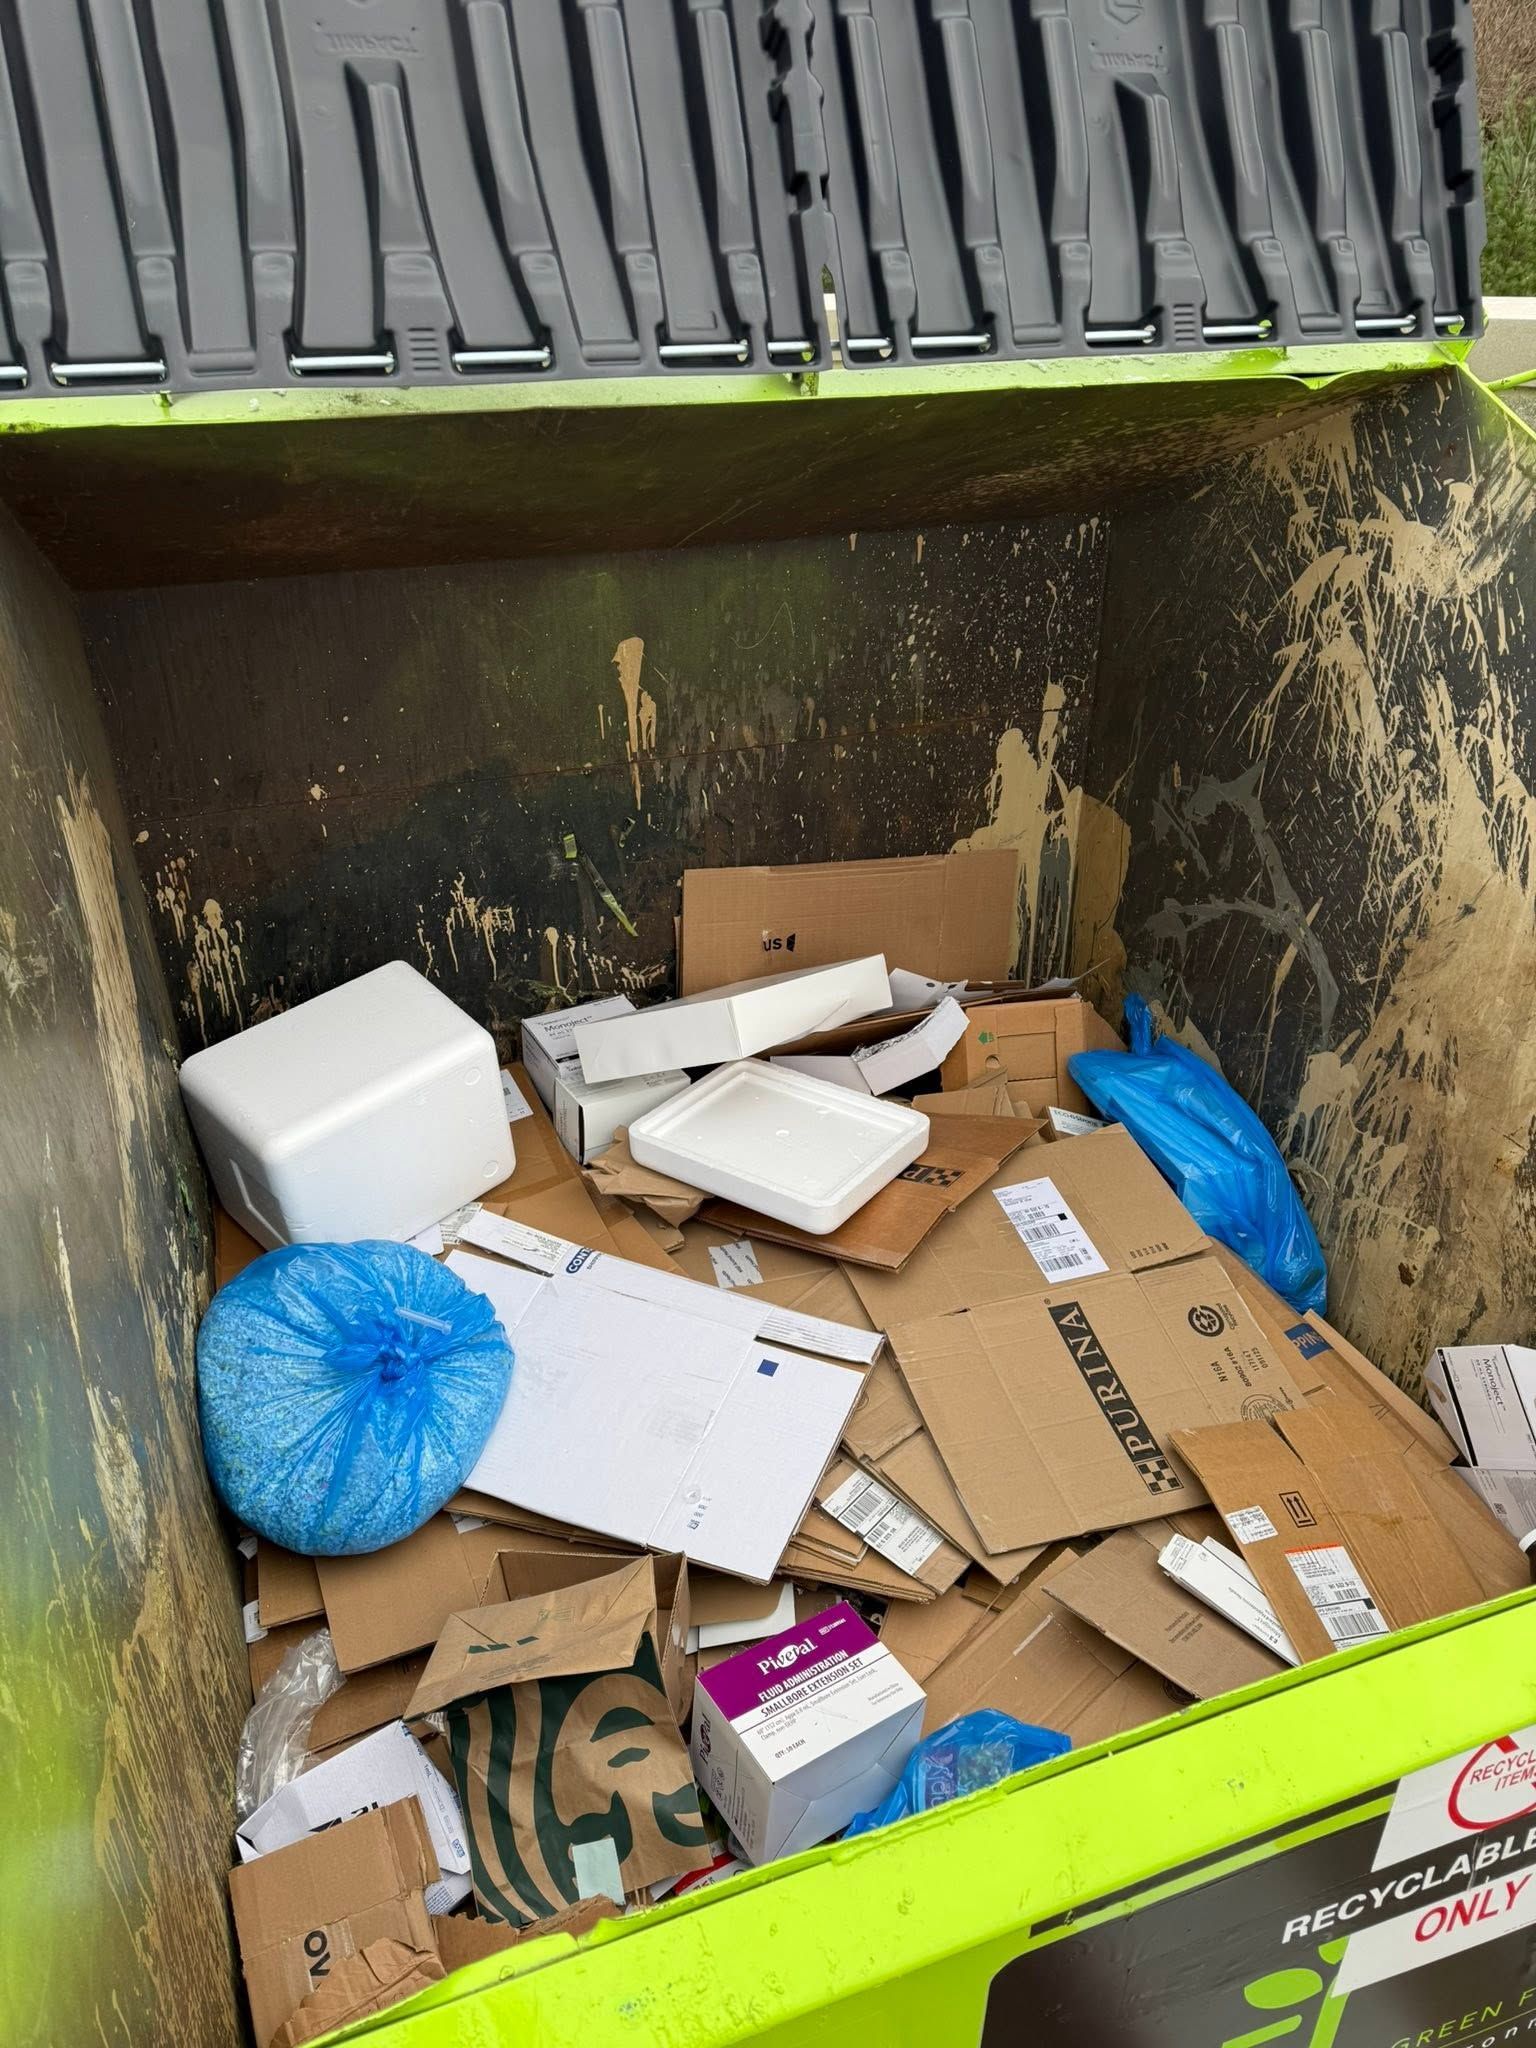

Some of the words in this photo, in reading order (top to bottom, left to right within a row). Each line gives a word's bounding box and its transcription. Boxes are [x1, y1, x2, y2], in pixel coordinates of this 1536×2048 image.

[1058, 1306, 1158, 1457] PURINA
[1482, 1358, 1504, 1406] Monoject
[757, 1638, 818, 1676] Pivetal
[758, 1684, 784, 1703] FLUID
[784, 1649, 849, 1693] ADMINISTRATION
[761, 1686, 810, 1718] SMALLBORE
[807, 1666, 850, 1693] EXTENSION
[849, 1657, 864, 1673] SET
[1494, 1766, 1536, 1791] ITEM
[1281, 1826, 1536, 1945] RECYCLABLE
[1414, 1872, 1534, 1943] ONLY
